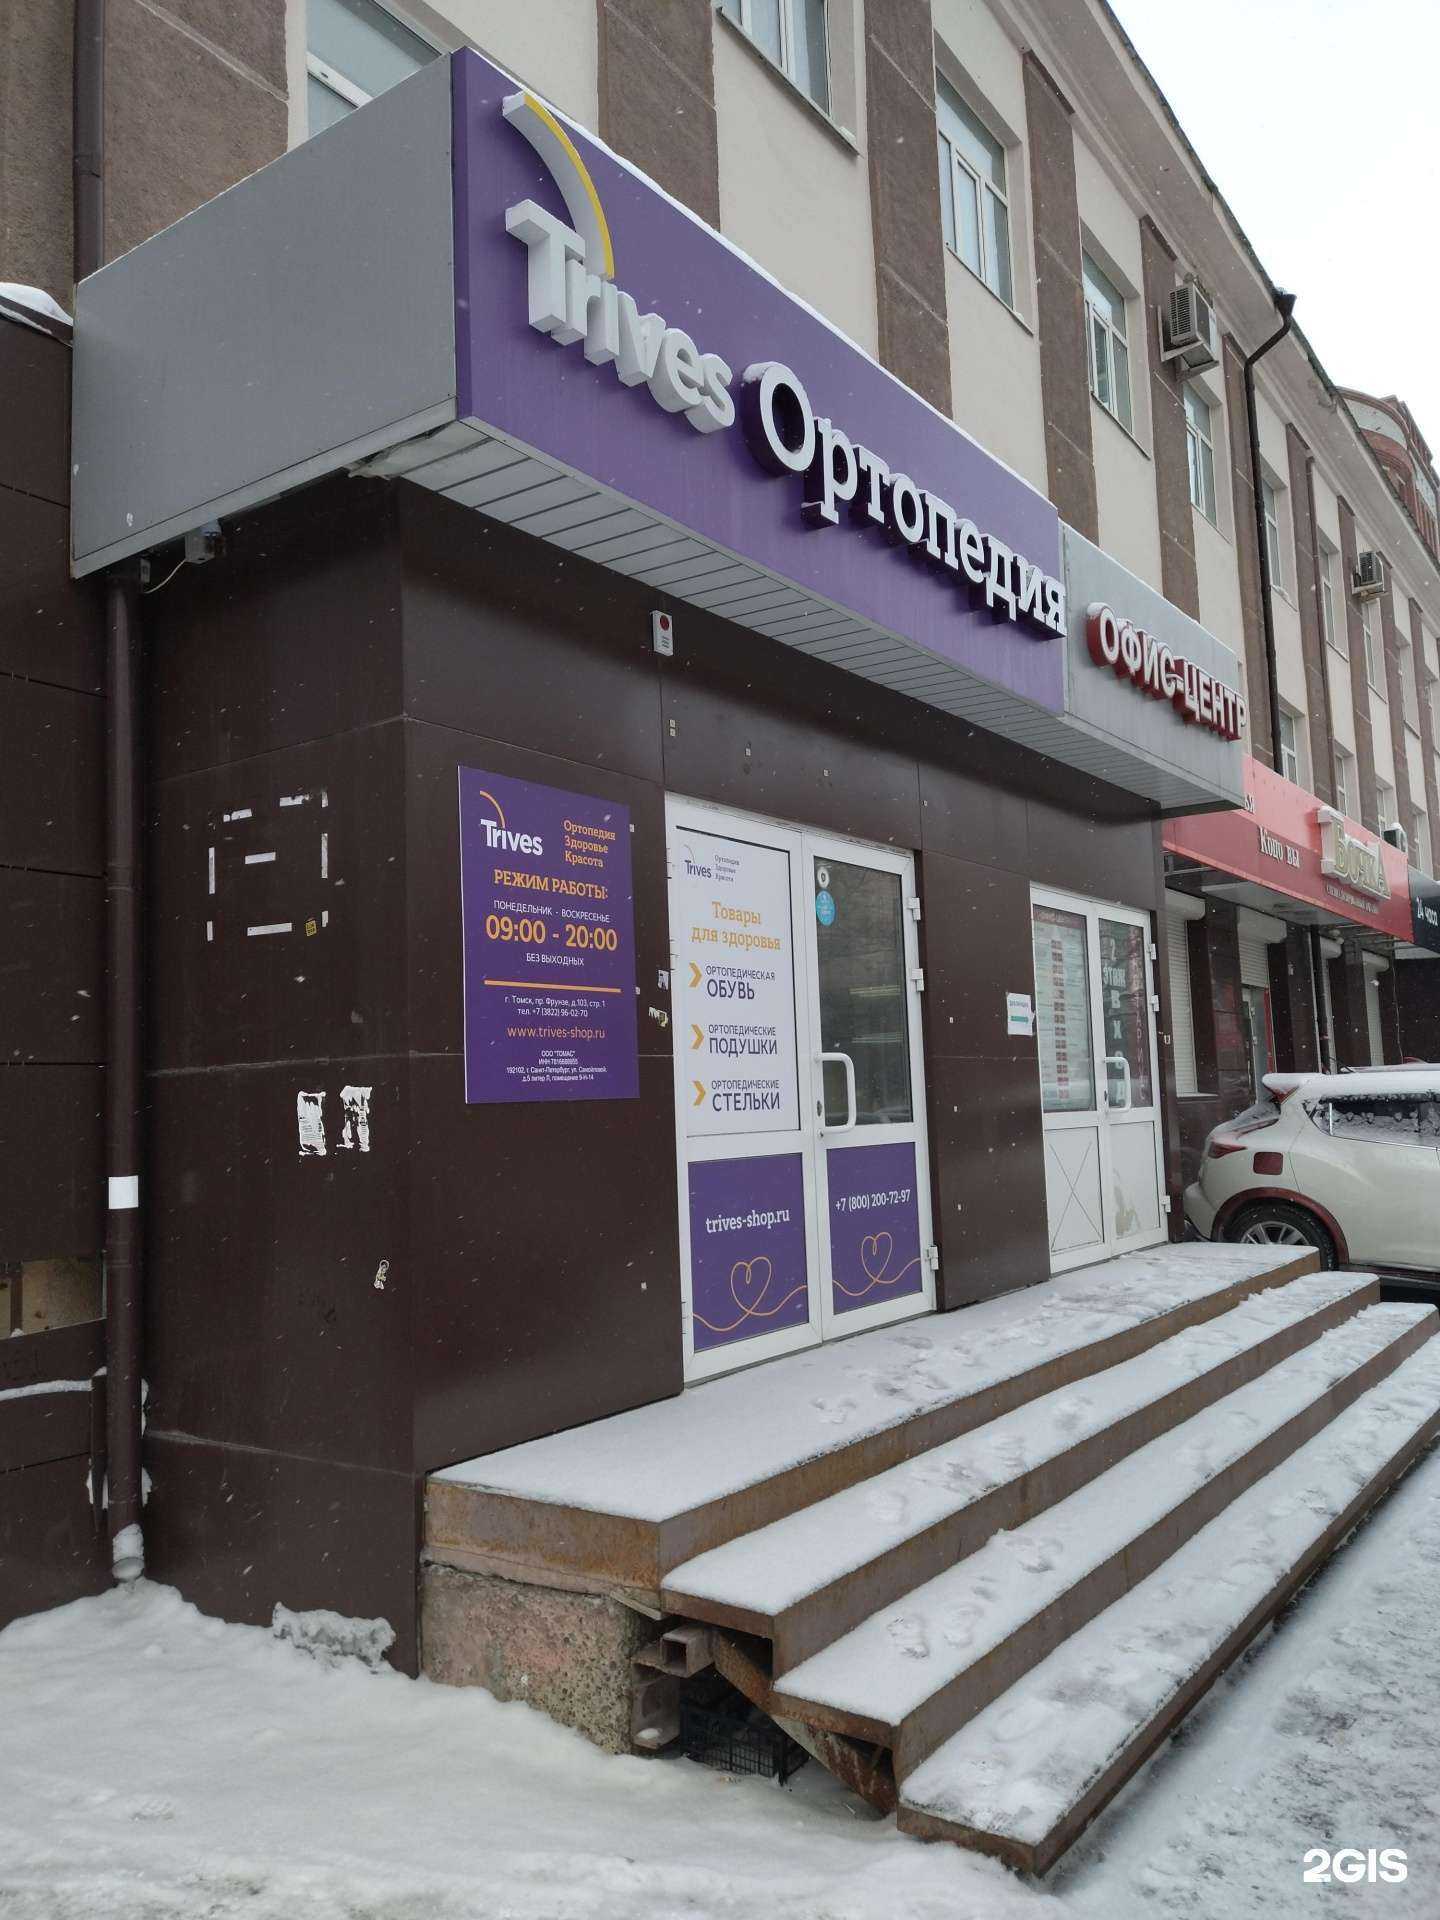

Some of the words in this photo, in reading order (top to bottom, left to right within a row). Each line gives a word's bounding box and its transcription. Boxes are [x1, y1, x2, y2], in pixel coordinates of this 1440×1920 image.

[505, 199, 737, 435] Trives
[744, 362, 1067, 638] Ортопедия
[1089, 602, 1248, 740] ОФИС-ЦЕНТР
[480, 818, 544, 856] Trives
[563, 819, 616, 841] Ортопедия
[564, 835, 609, 854] Здоровье
[564, 850, 604, 868] Красота
[684, 859, 712, 879] Trives
[493, 869, 550, 891] РЕЖИМ
[551, 878, 609, 900] РАБОТЫ:
[493, 900, 552, 916] ПОНЕДЕЛЬНИК
[561, 908, 610, 923] ВОСКРЕСЕНЬЕ
[711, 901, 762, 928] Товары
[486, 914, 546, 944] 09:00
[565, 923, 617, 951] 20:00
[690, 927, 718, 943] для
[722, 930, 781, 952] здоровья
[526, 952, 540, 963] БЕЗ
[541, 955, 585, 966] ВЫХОДНЫХ
[705, 965, 775, 981] ОРТОПЕДИЧЕСКАЯ
[707, 979, 755, 1000] ОБУВЬ
[507, 1026, 606, 1041] www.trives-shop.ru
[708, 1024, 776, 1036] ОРТОПЕДИЧЕСКИЕ
[709, 1037, 778, 1058] ПОДУШКИ
[712, 1080, 780, 1092] ОРТОПЕДИЧЕСКИЕ
[712, 1092, 780, 1112] СТЕЛЬКИ
[835, 1198, 847, 1211] +7
[848, 1194, 870, 1212] (800)
[871, 1189, 911, 1207] 200-72-97
[706, 1209, 790, 1233] trives-shop.ru
